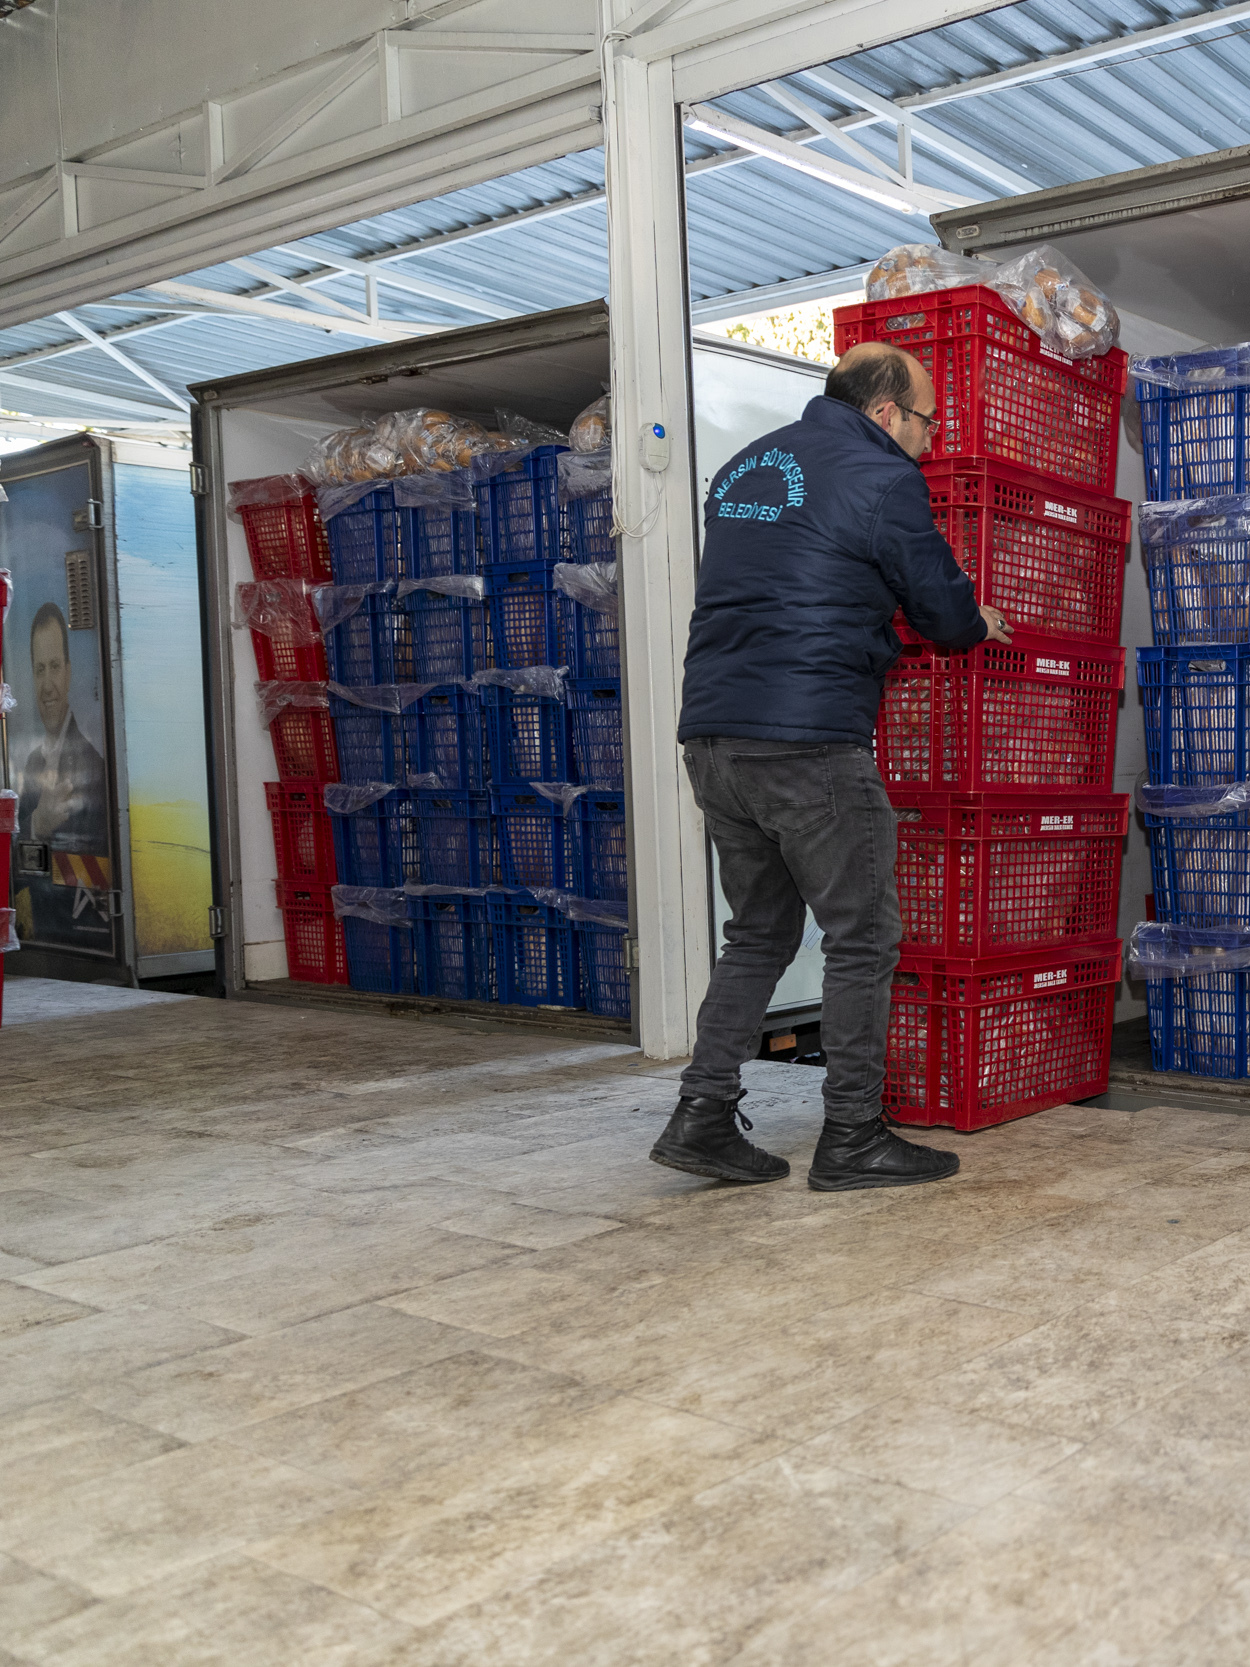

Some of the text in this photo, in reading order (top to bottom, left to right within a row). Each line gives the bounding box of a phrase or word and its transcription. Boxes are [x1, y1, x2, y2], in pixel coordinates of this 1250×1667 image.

[714, 447, 808, 507] MERSİN BÜYÜKŞEHİR
[717, 502, 784, 522] BELEDİYESİ
[1044, 500, 1078, 518] MER-EK
[1036, 657, 1070, 670] MER-EK
[1040, 815, 1074, 825] MER-EK
[1033, 968, 1068, 983] MER-EK
